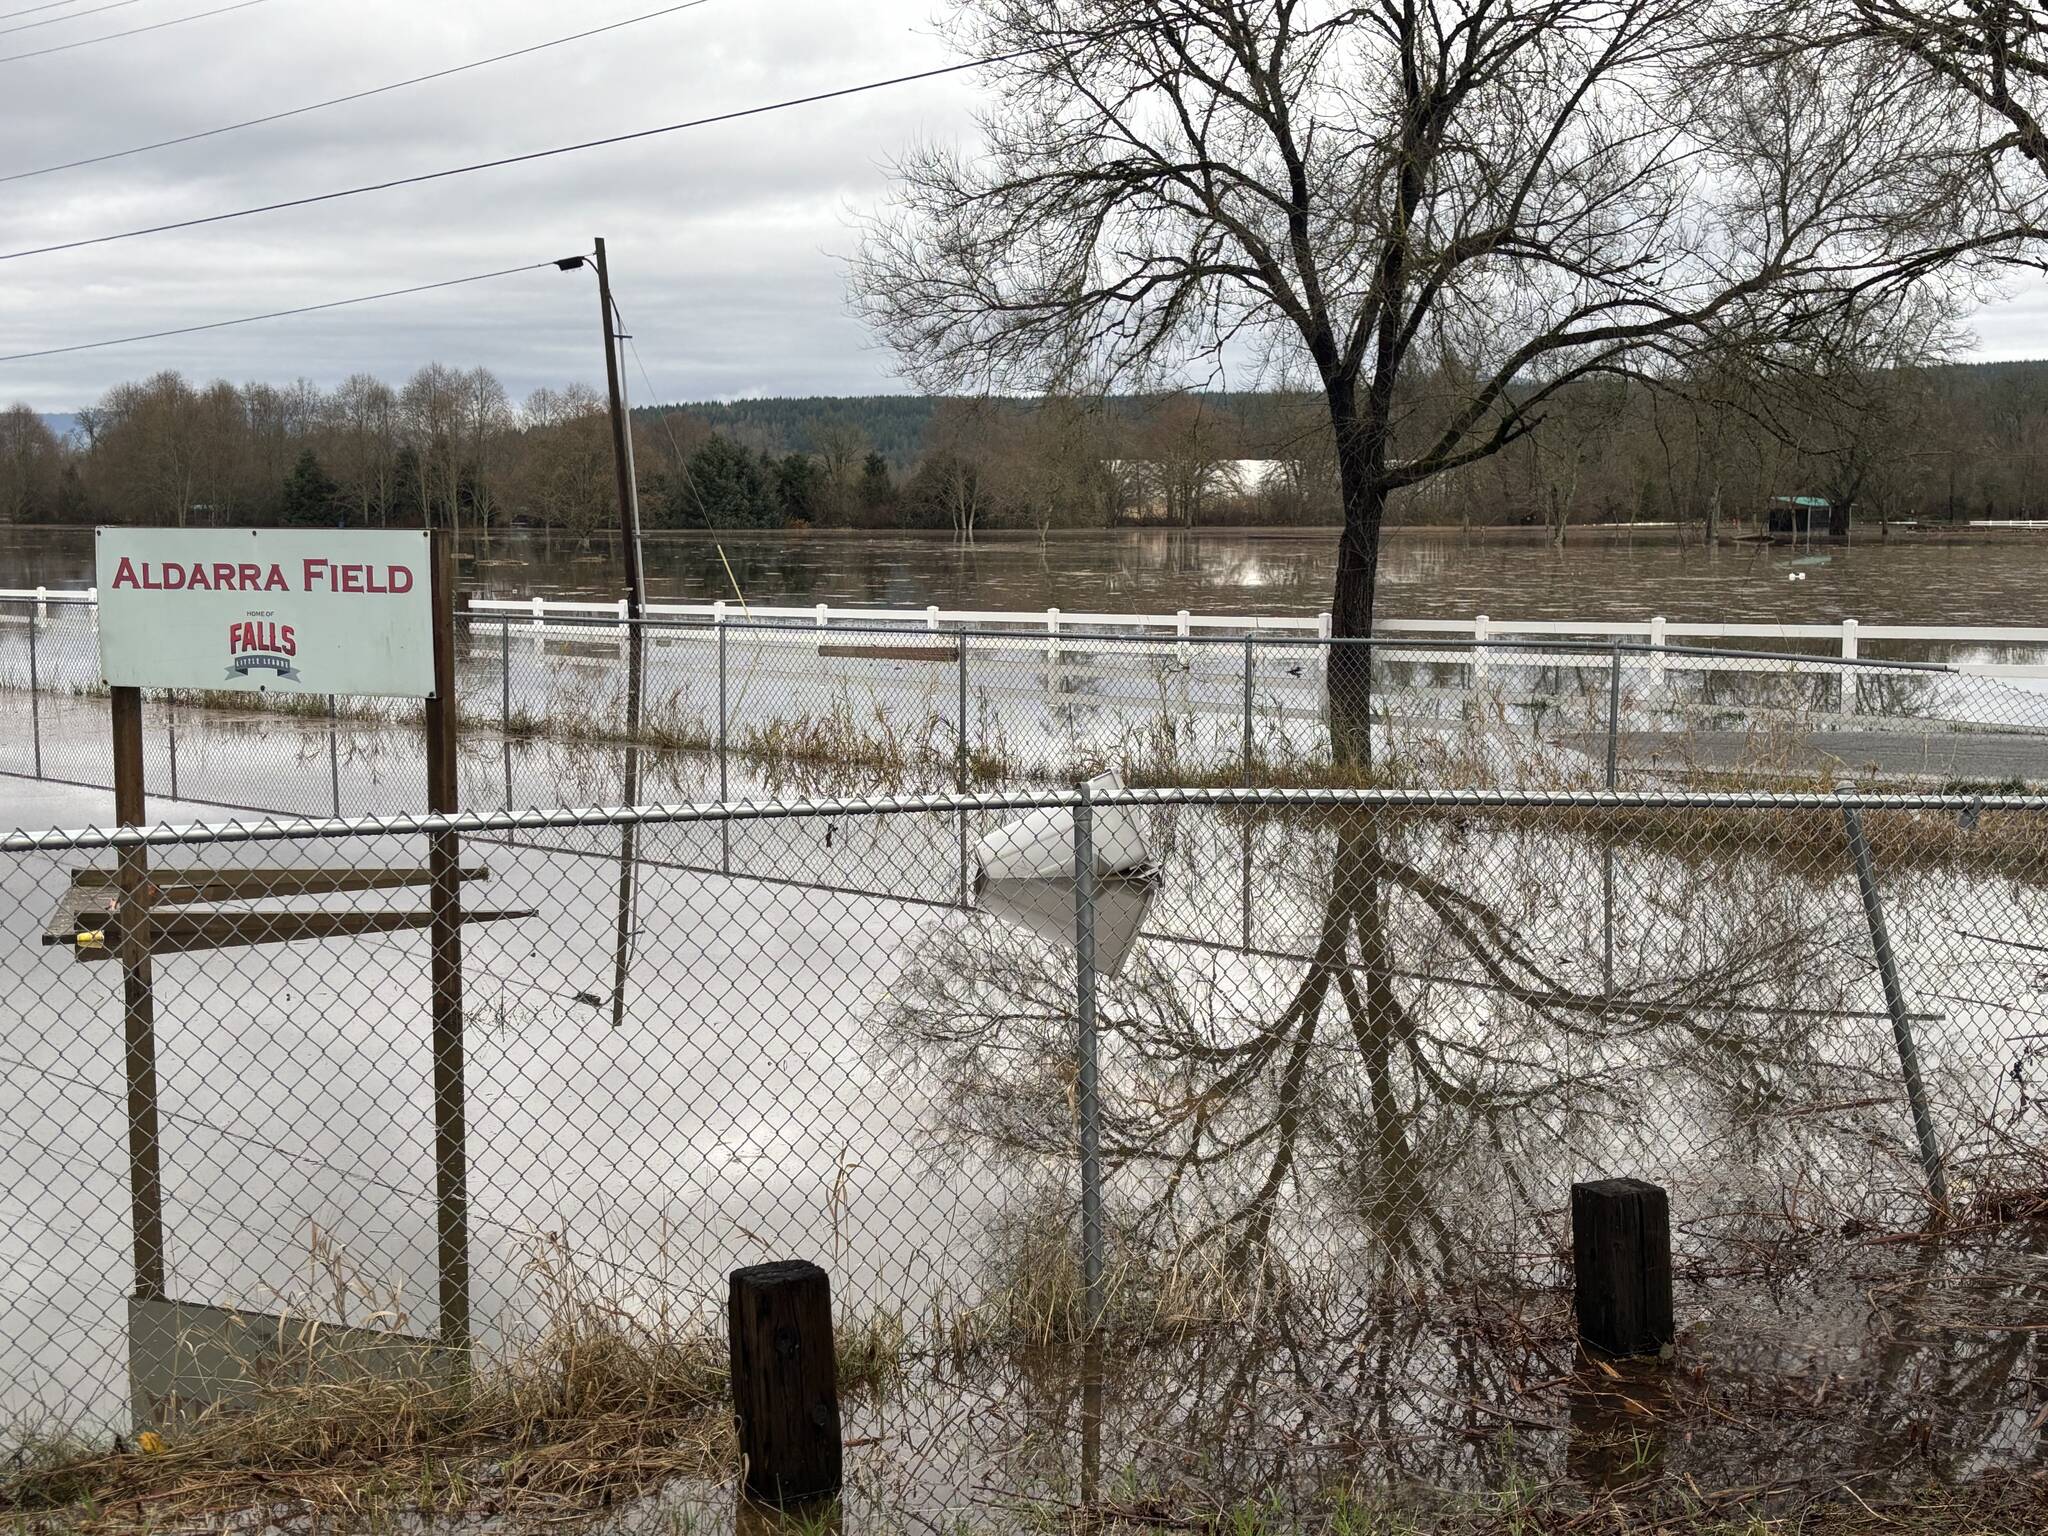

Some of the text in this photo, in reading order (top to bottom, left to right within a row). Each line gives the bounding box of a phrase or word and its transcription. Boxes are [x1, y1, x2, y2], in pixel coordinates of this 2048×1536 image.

[112, 556, 414, 594] ALDARRA FIELD
[230, 621, 296, 656] FALLS
